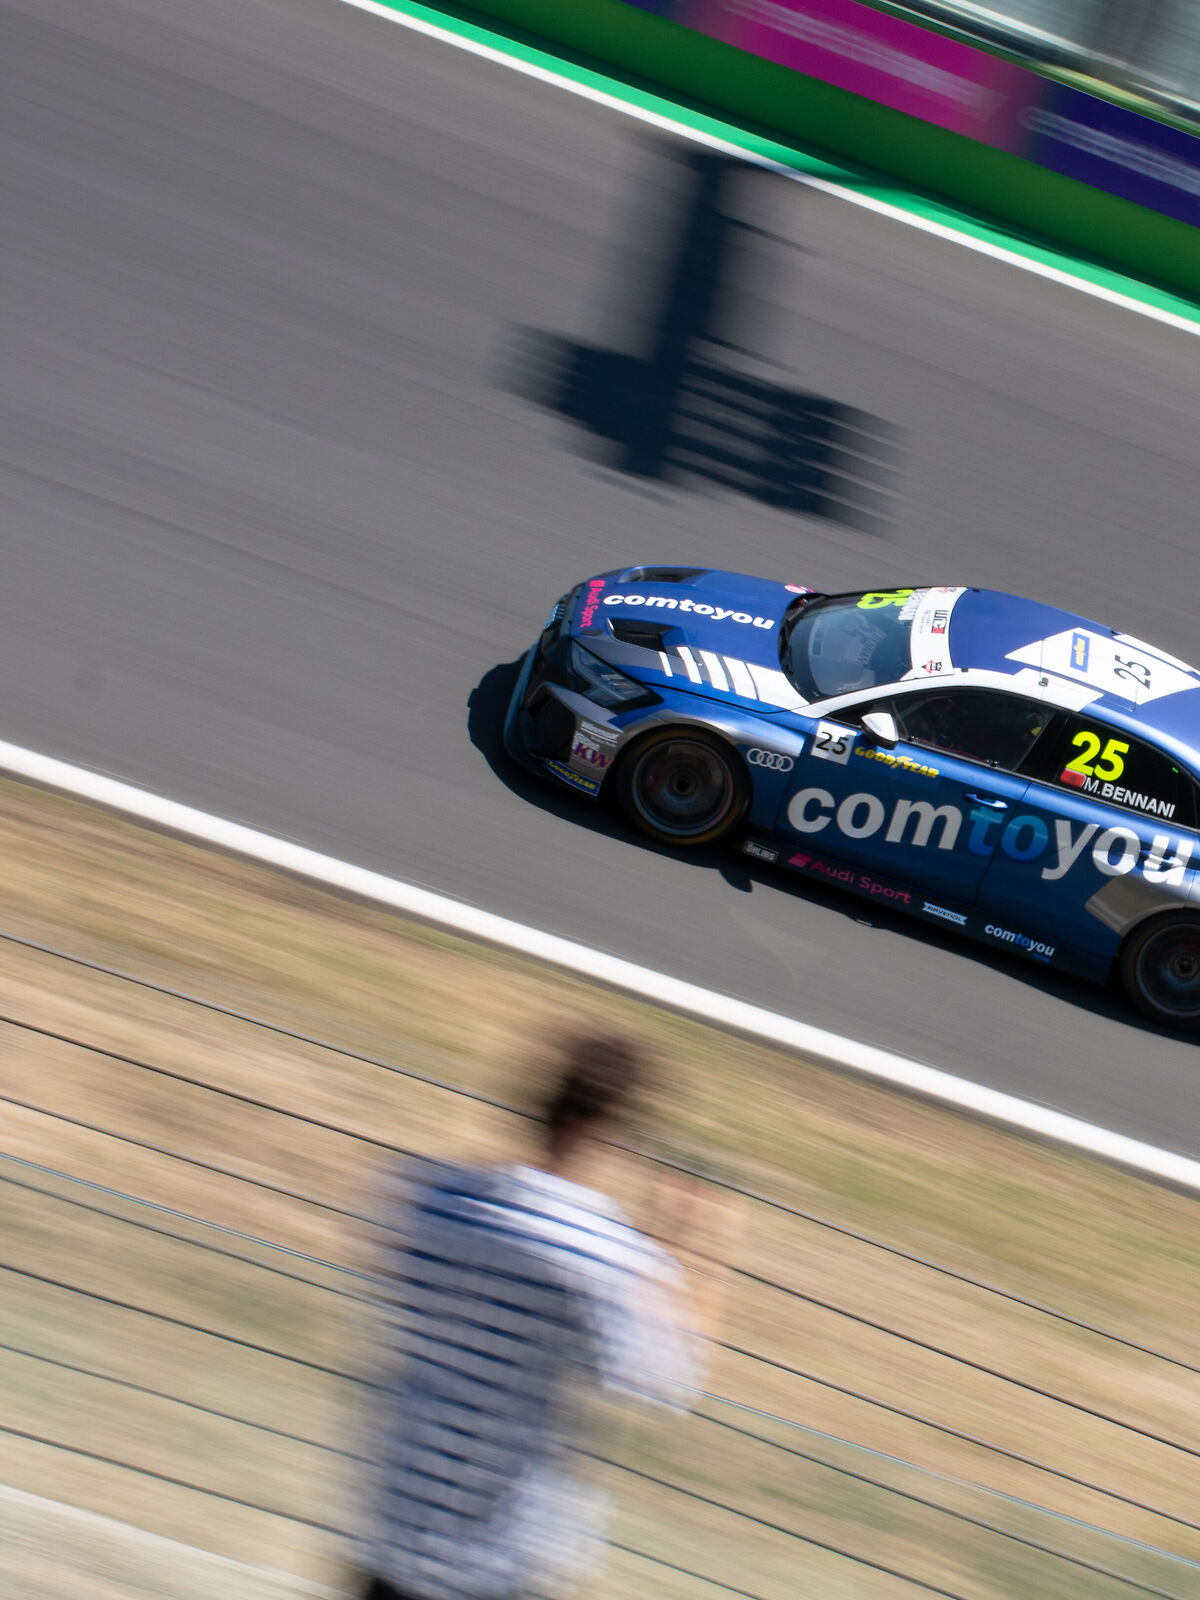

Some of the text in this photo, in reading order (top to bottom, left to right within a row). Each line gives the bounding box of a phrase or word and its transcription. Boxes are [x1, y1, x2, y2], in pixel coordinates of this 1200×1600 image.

[580, 605, 599, 628] Sport
[603, 593, 775, 630] comtoyou
[1113, 654, 1151, 690] 25
[574, 742, 614, 770] KW
[816, 731, 849, 756] 25
[1066, 731, 1130, 782] 25
[855, 746, 940, 778] GOODYEAR
[787, 787, 1195, 887] comtoyou
[810, 860, 912, 904] Audi Sport
[984, 922, 1056, 957] comtoyou
